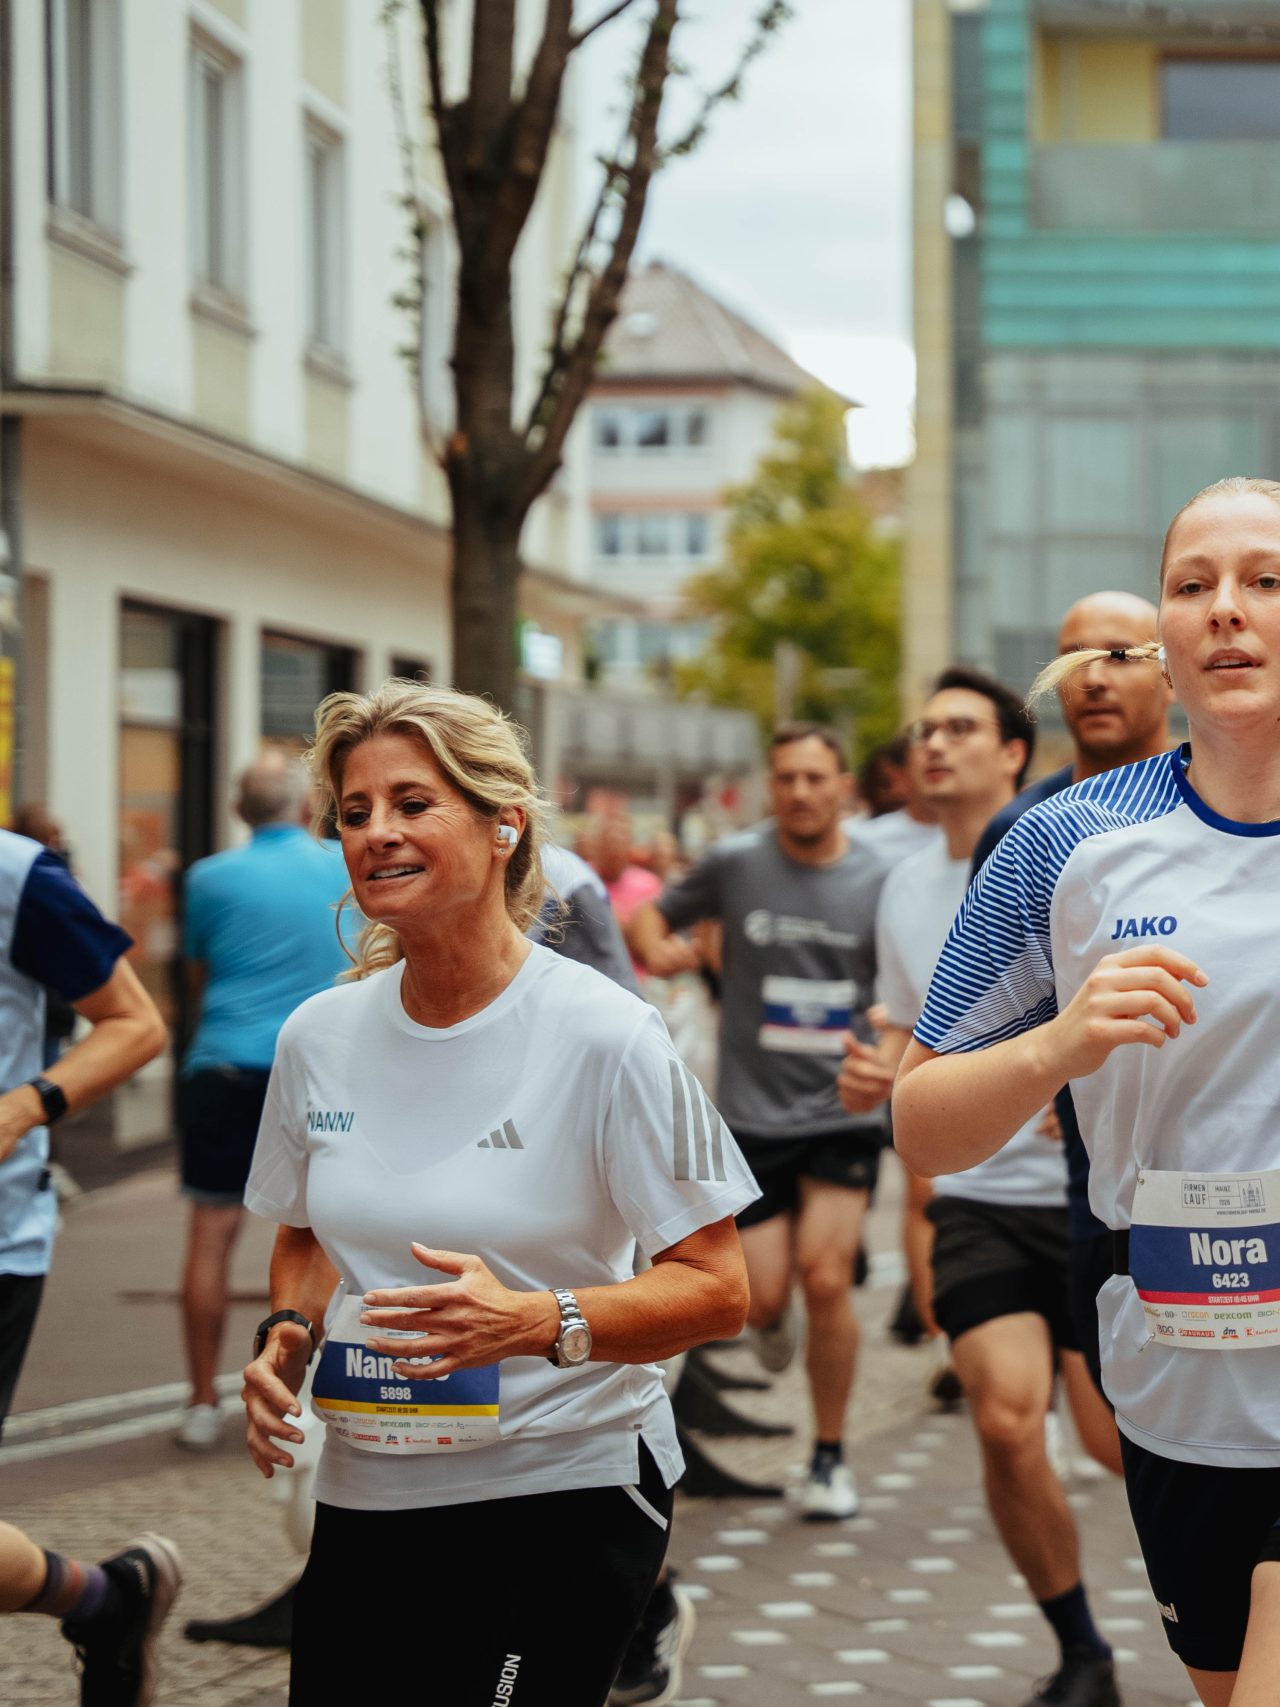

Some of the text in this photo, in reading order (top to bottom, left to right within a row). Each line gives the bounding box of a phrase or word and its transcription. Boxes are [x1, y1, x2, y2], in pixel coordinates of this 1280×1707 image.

[1111, 915, 1178, 940] JAKO
[1183, 1183, 1206, 1192] FIRMEN
[1184, 1193, 1206, 1205] LAUF
[1189, 1232, 1269, 1266] Nora
[1211, 1272, 1250, 1289] 6423
[1223, 1327, 1236, 1335] dm
[379, 1386, 412, 1401] 5898
[491, 1653, 522, 1707] USION
